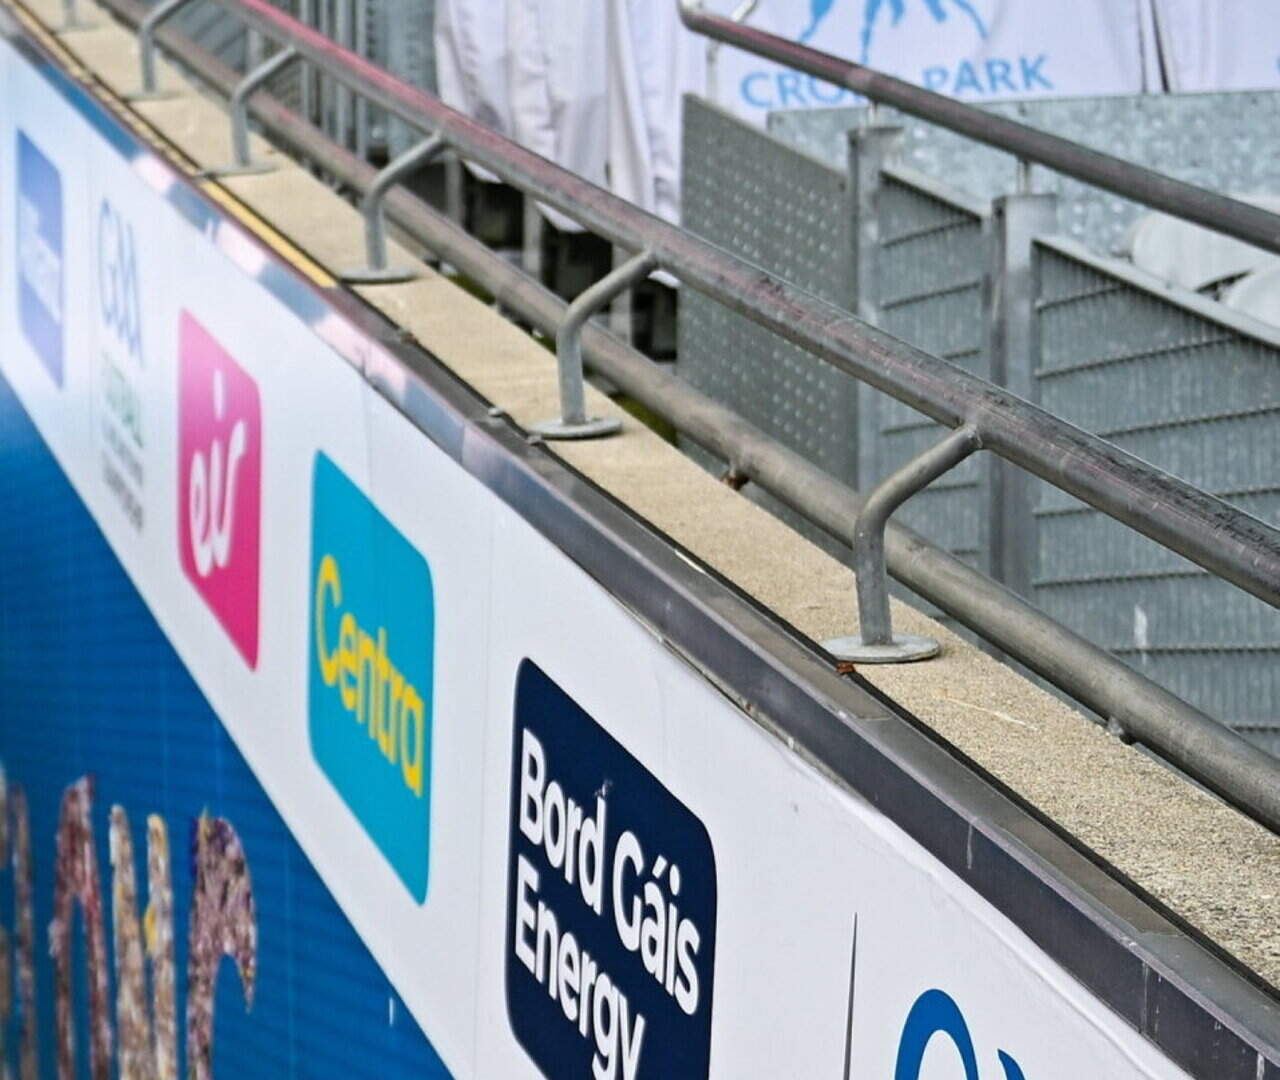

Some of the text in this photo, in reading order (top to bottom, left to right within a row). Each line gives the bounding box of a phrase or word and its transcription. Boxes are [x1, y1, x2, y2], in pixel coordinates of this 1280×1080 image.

[923, 54, 1053, 94] PARK
[189, 369, 248, 578] eir
[315, 553, 425, 797] Centra
[519, 727, 700, 1016] Bord Gáis
